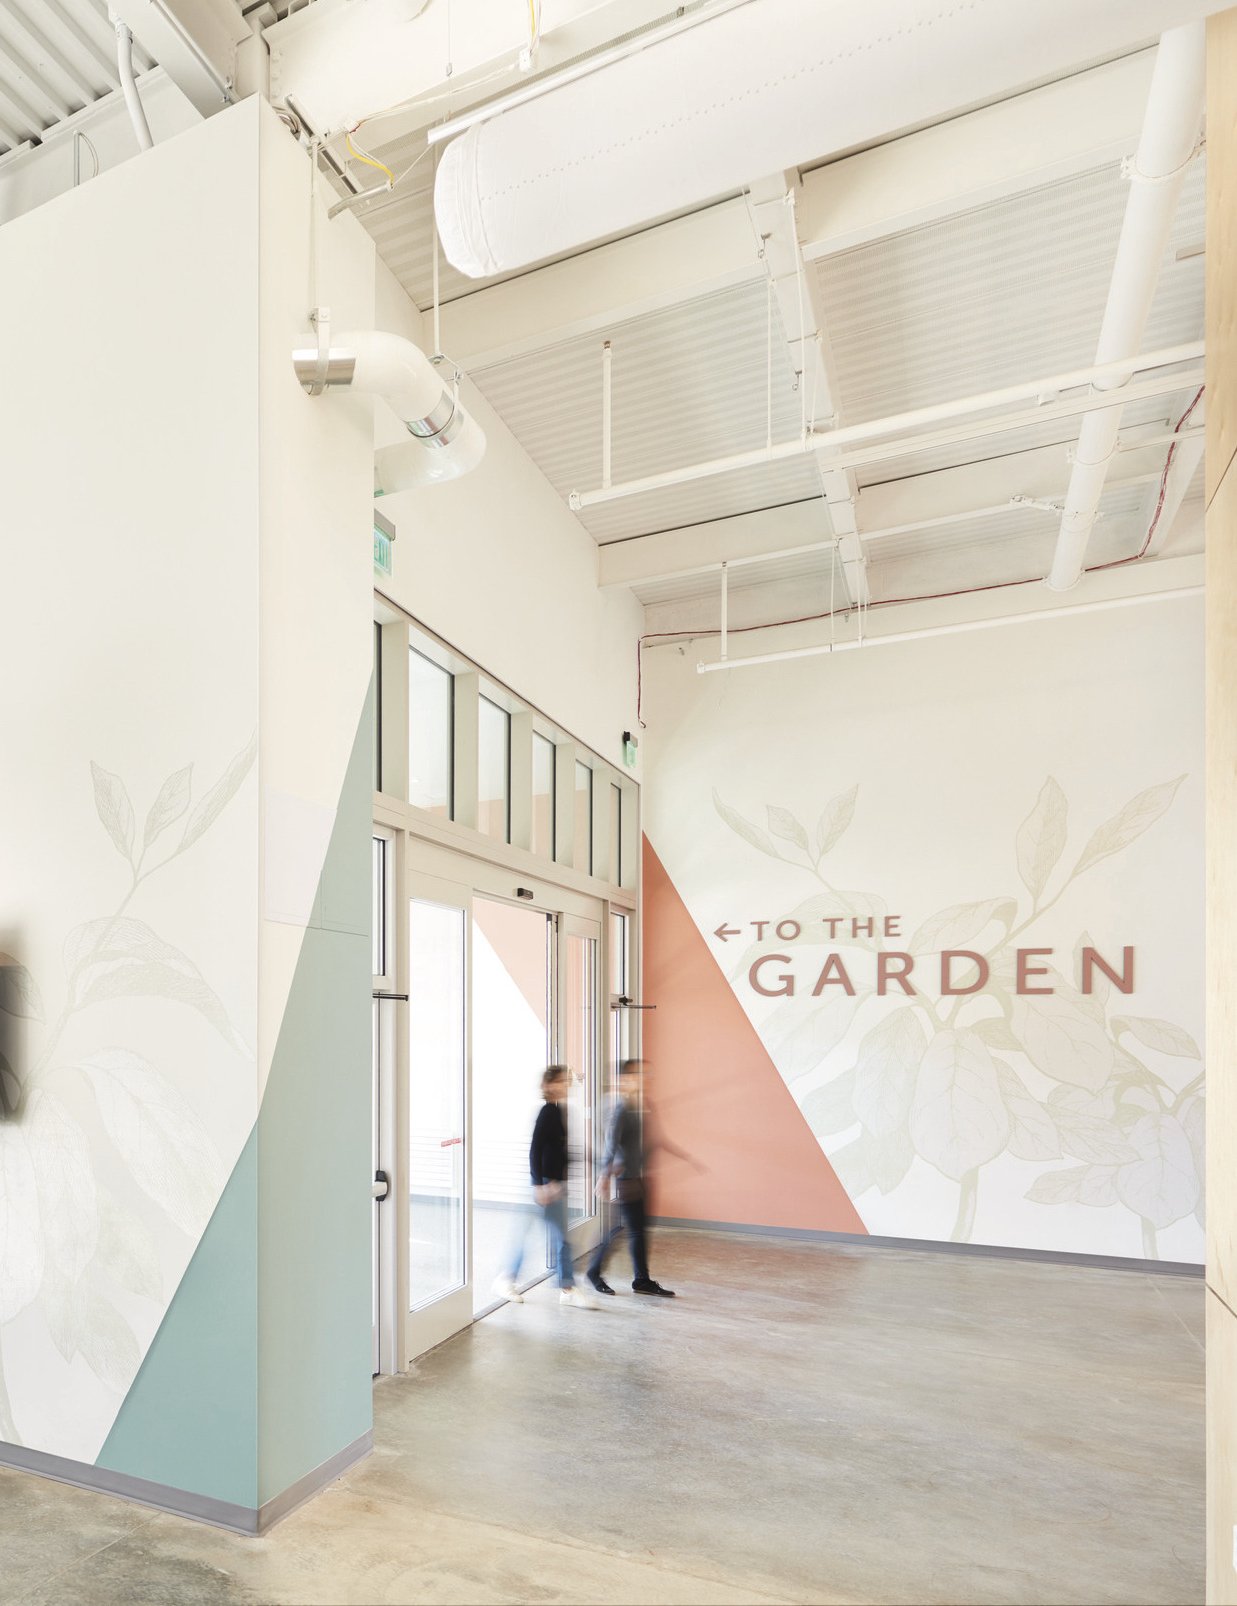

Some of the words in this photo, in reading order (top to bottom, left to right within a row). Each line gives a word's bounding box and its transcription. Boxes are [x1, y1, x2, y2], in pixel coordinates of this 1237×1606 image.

[750, 919, 801, 942] TO
[823, 915, 901, 939] THE
[748, 945, 1134, 998] GARDEN
